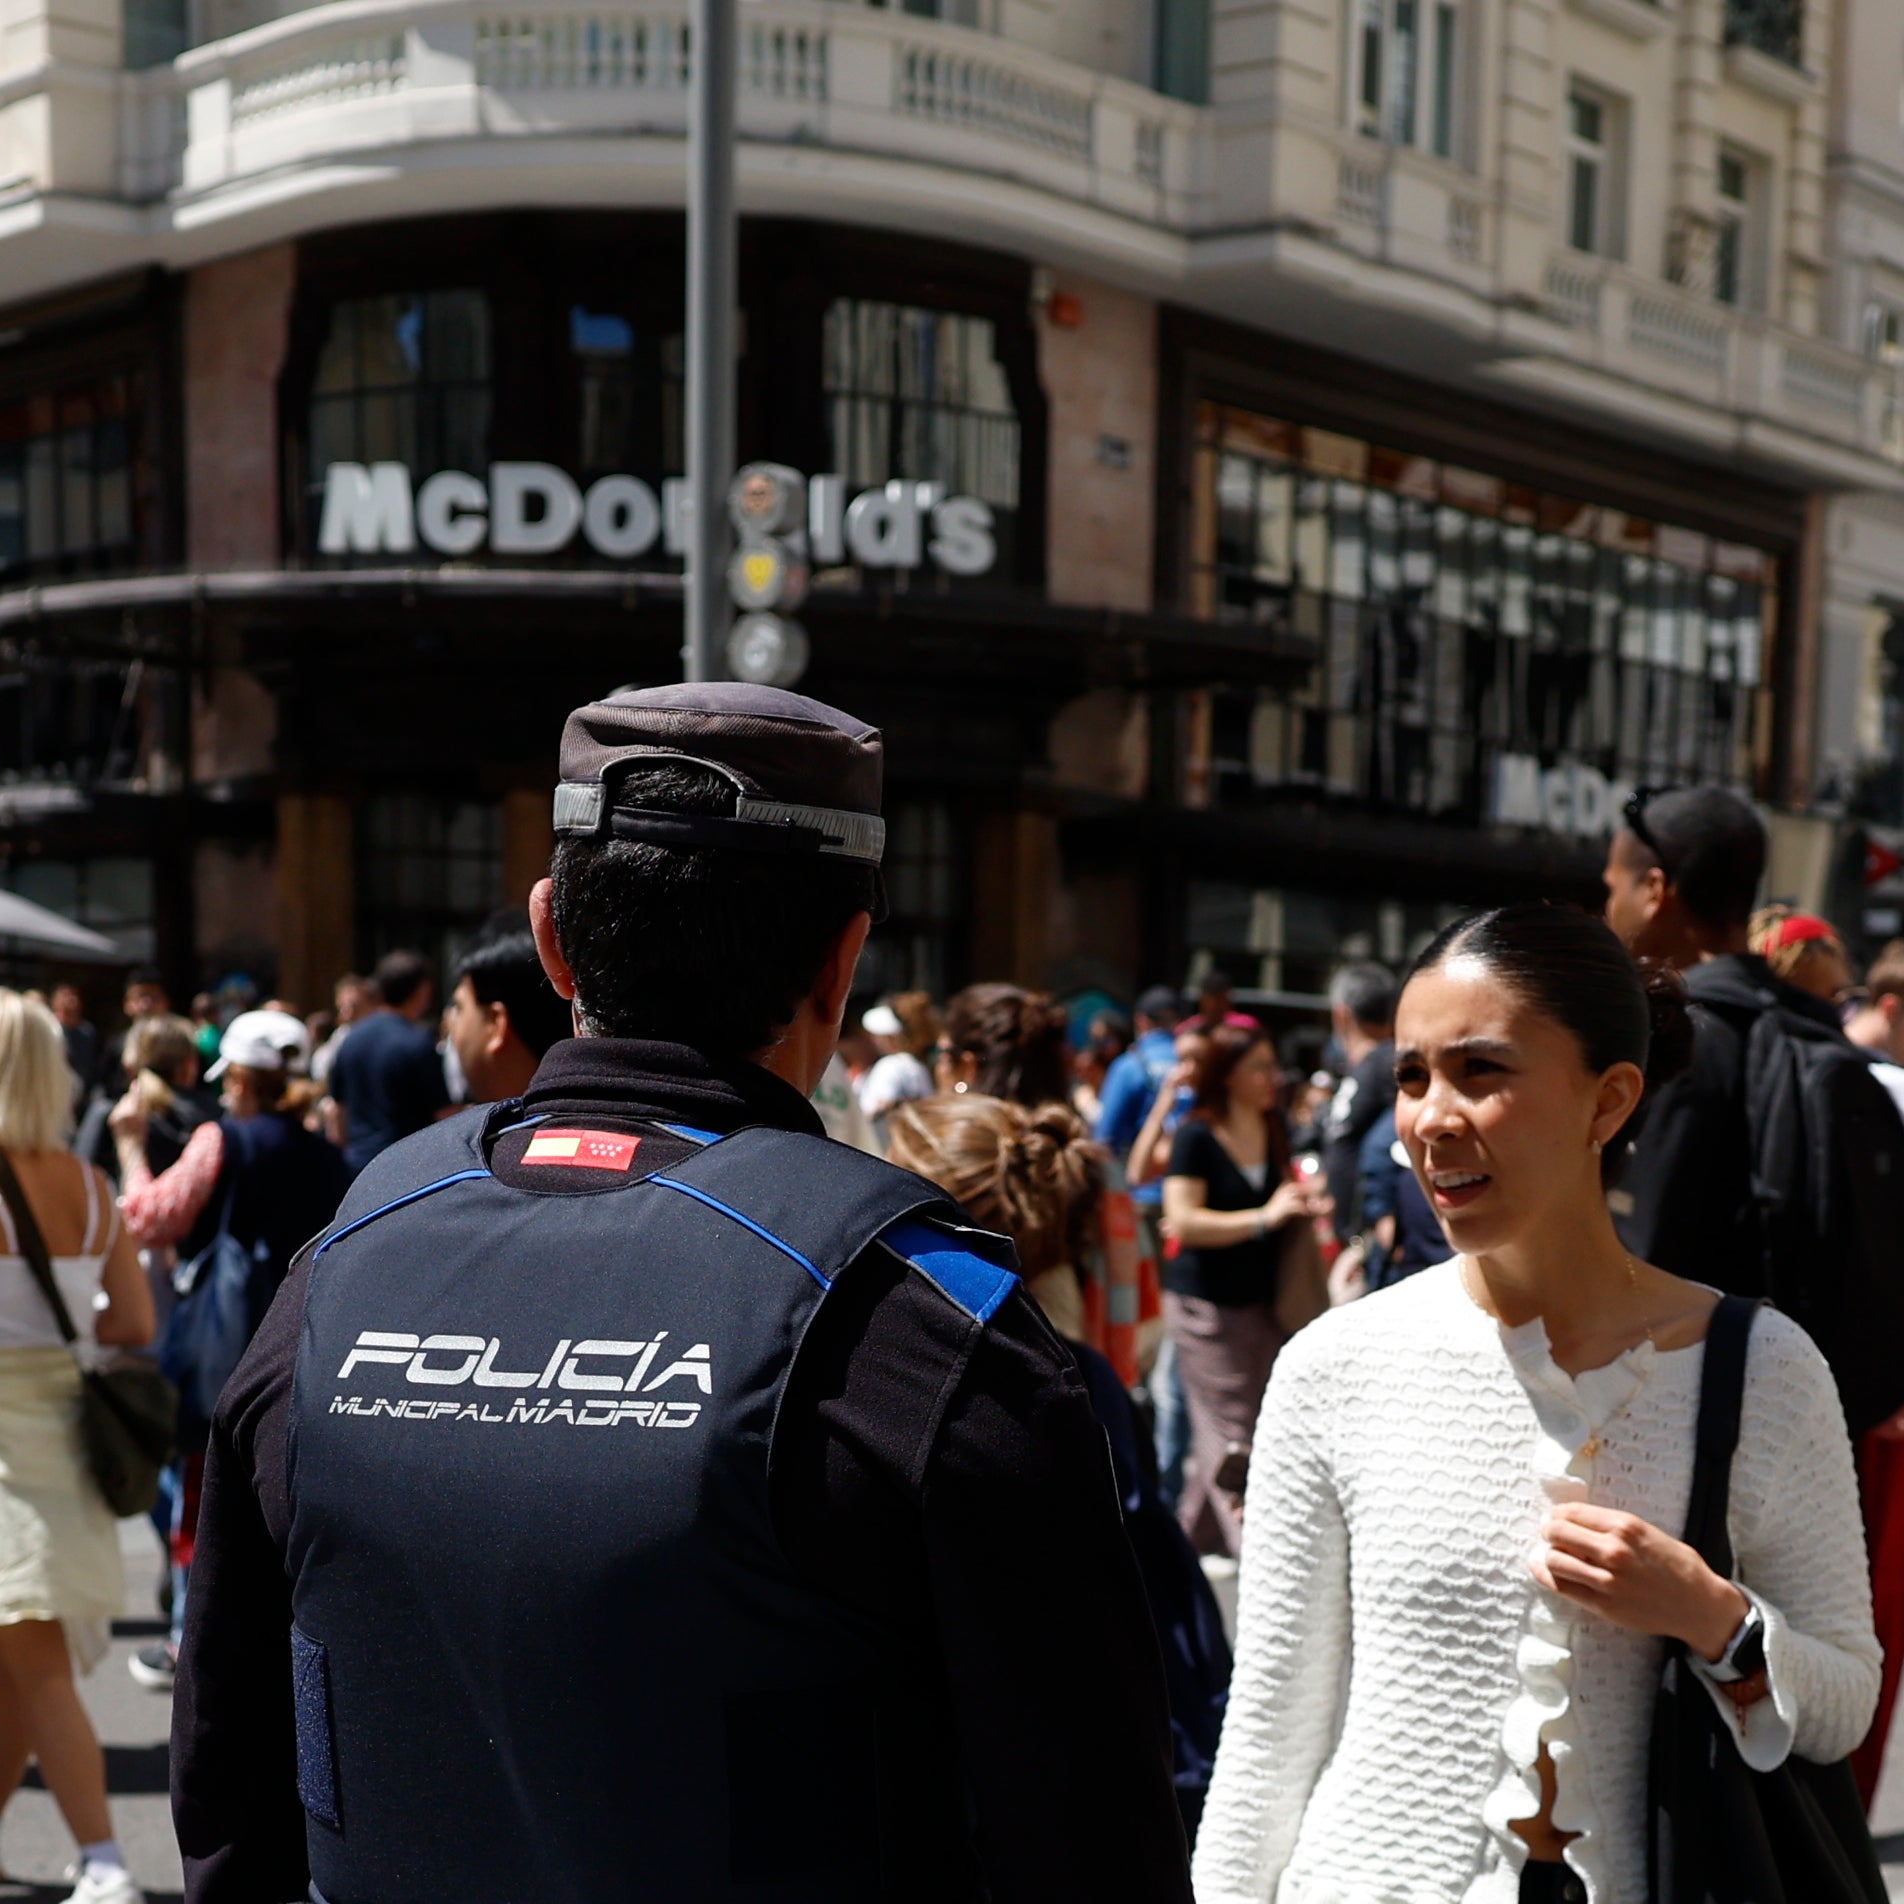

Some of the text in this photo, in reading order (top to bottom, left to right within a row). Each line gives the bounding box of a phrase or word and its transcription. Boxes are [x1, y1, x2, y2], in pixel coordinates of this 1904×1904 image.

[318, 461, 996, 575] McDold's
[337, 1331, 713, 1395] POLICÍA
[329, 1396, 702, 1428] MUNICIPAL MADRID
